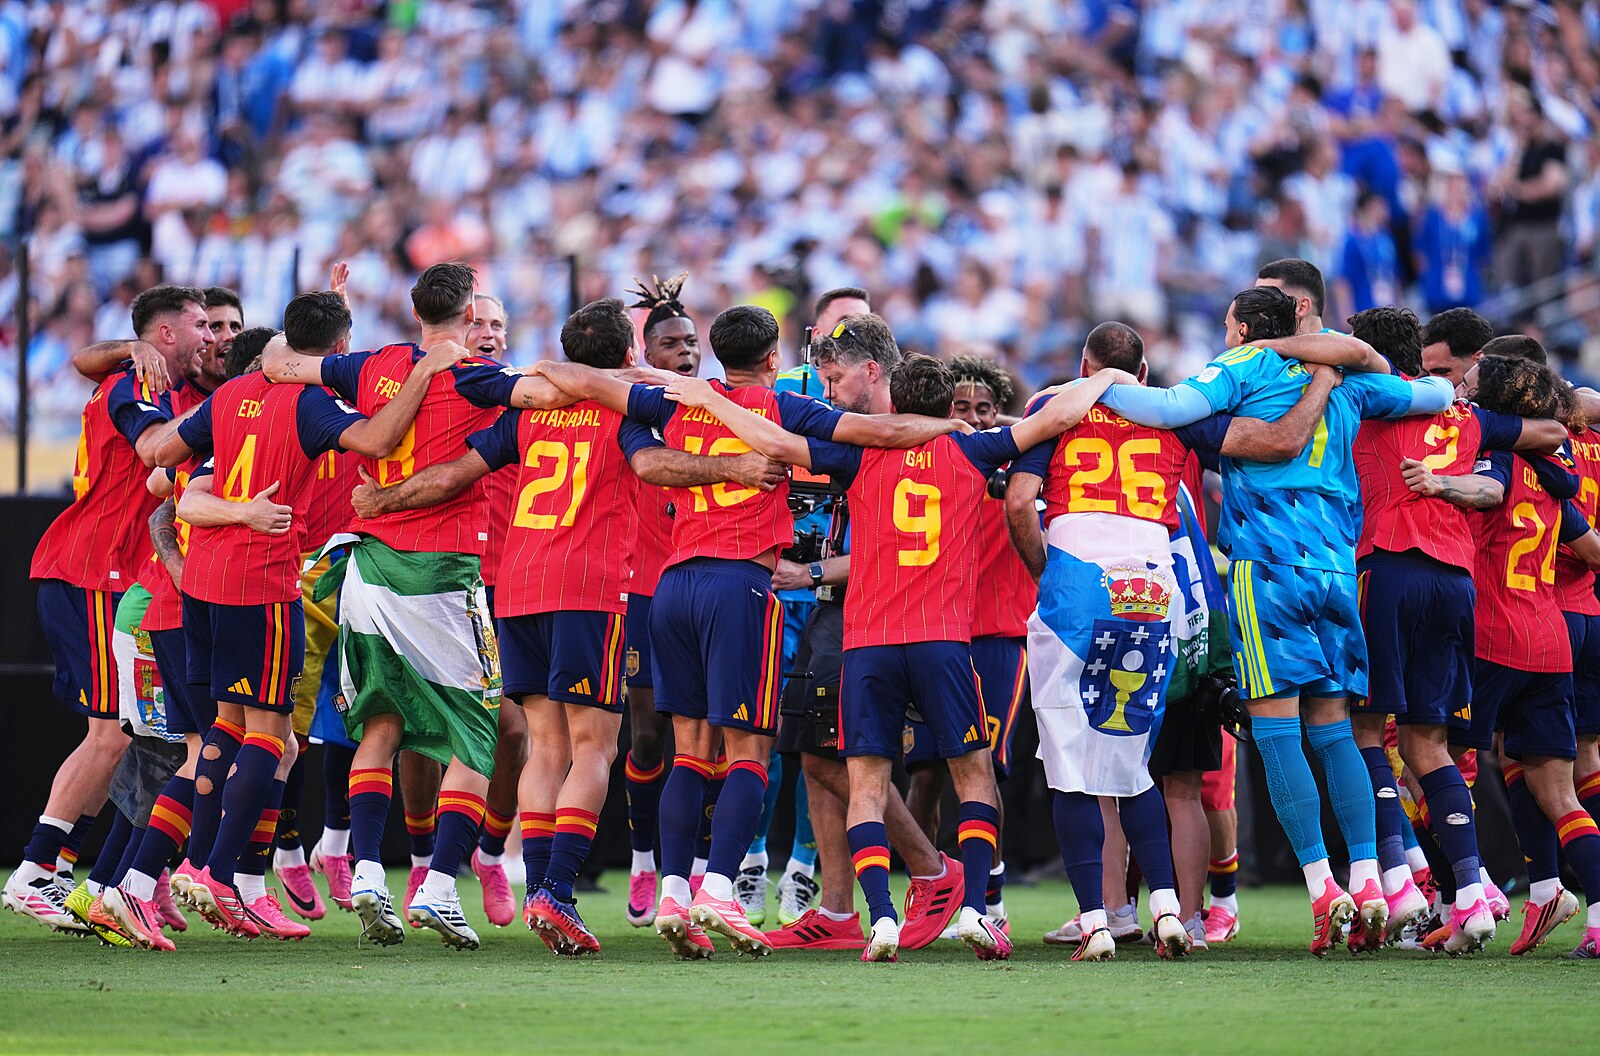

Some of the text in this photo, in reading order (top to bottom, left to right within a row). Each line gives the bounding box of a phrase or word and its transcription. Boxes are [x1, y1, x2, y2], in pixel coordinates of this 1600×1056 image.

[222, 434, 258, 503] 4
[1064, 437, 1168, 520] 26
[1422, 424, 1460, 474] 2
[512, 440, 591, 530] 21
[892, 477, 942, 567] 9
[1506, 502, 1563, 593] 24
[1181, 638, 1201, 656] WORL
[1187, 612, 1205, 629] FIFA
[1236, 651, 1247, 690] 1
